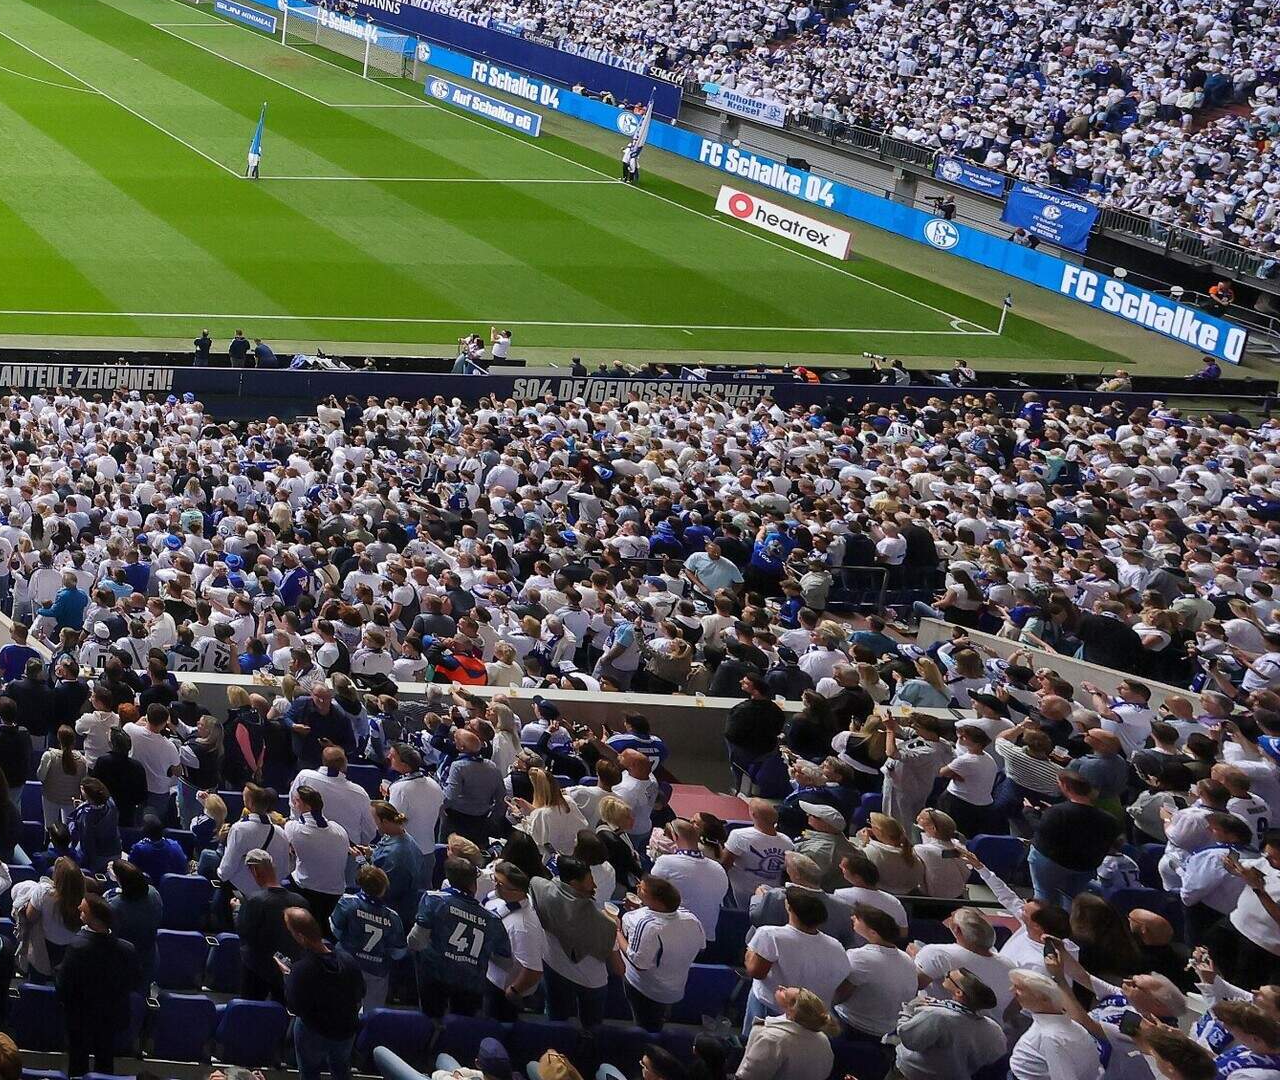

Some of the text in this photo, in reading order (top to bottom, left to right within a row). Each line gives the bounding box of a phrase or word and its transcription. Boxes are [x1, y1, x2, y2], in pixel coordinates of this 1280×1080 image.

[216, 1, 272, 28] SUN MINIMEAL
[471, 60, 559, 109] FC Schalke 04
[452, 89, 531, 130] Auf Schalke eG
[723, 89, 767, 110] Anholter
[726, 98, 761, 117] Kreisel
[699, 139, 835, 208] FC Schalke 04
[756, 204, 830, 247] heatrex
[1060, 263, 1098, 303] FC
[1100, 275, 1219, 351] Schalke
[0, 366, 73, 389] ANTEILE
[76, 368, 174, 390] ZEICHNEN!
[357, 909, 391, 927] SCHALKE 04
[450, 905, 487, 927] SCHALKE 04
[363, 924, 384, 953] 7
[448, 921, 484, 958] 41
